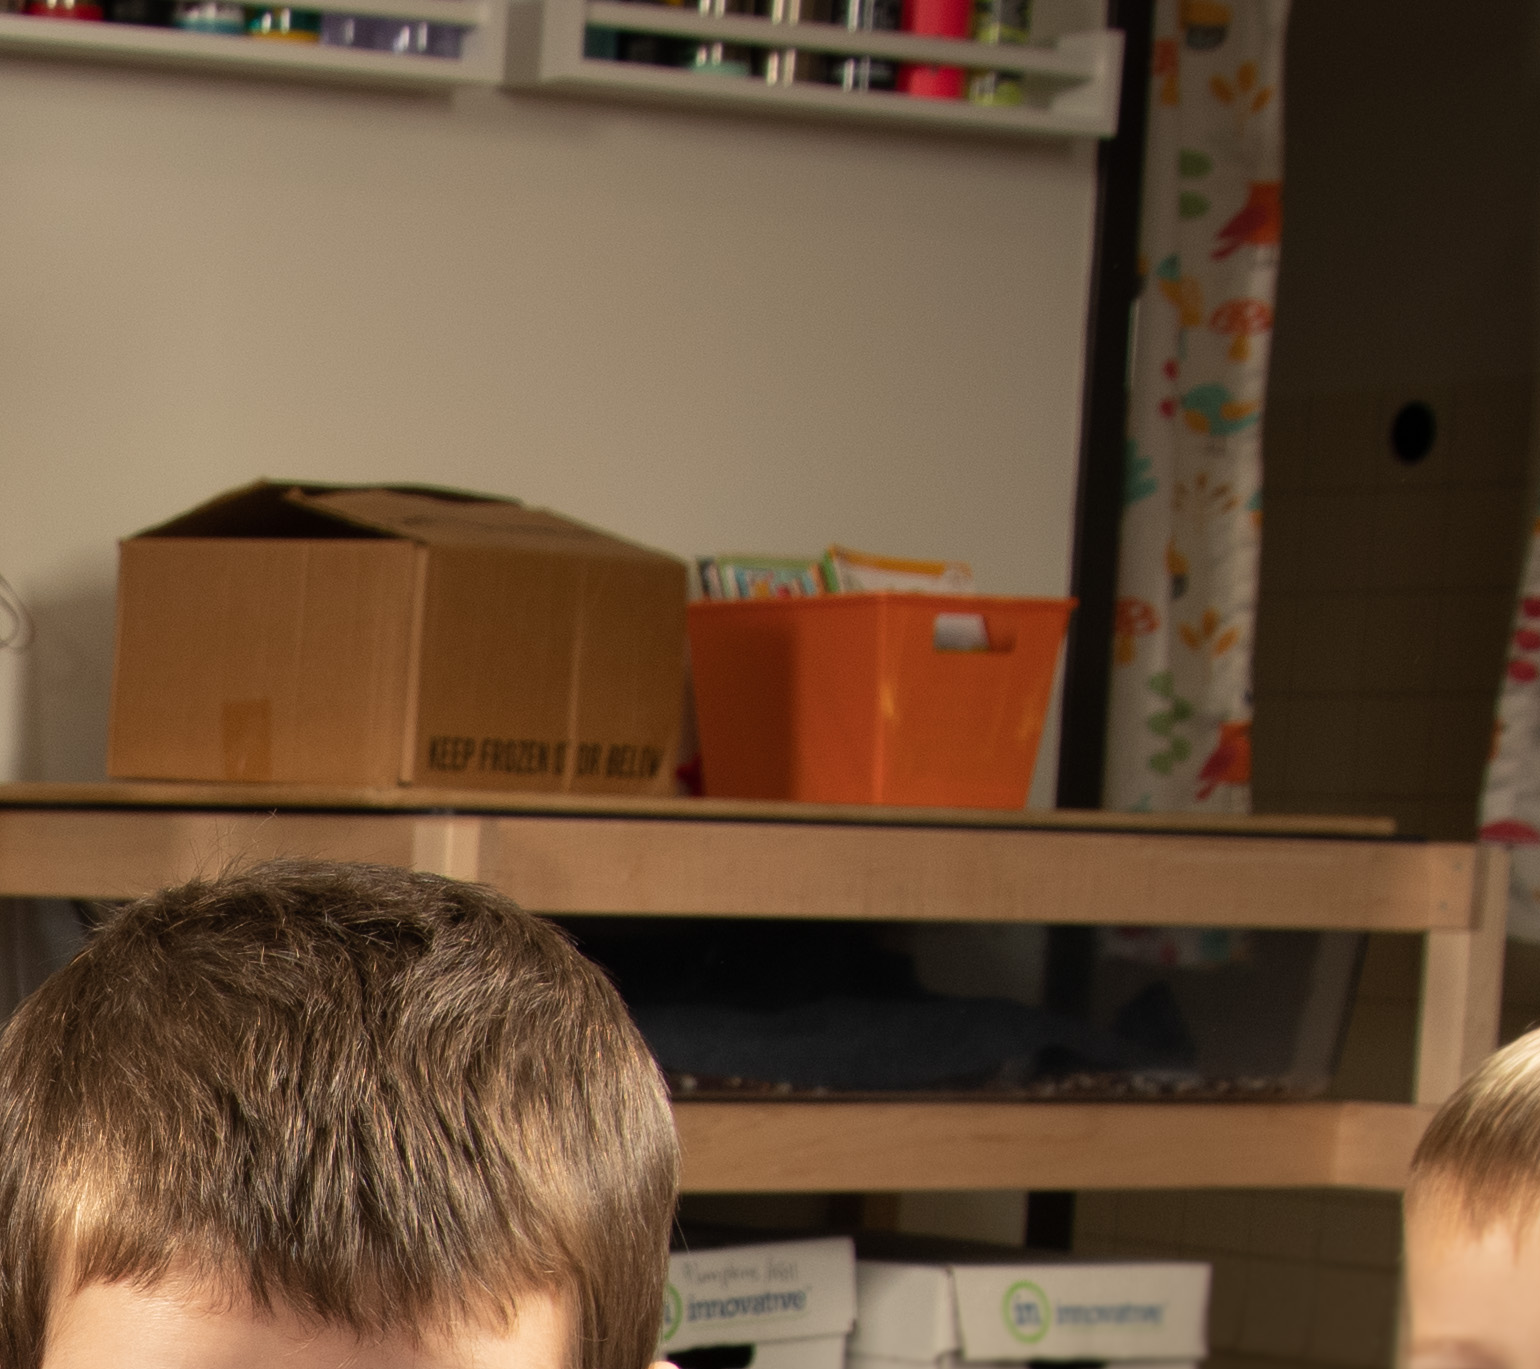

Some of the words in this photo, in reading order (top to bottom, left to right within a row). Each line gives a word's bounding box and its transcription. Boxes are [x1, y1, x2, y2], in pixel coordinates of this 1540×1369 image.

[427, 735, 473, 772] KEEP
[478, 736, 549, 775] FROZEN
[575, 741, 602, 777] OR
[605, 742, 664, 779] BELOW
[687, 1289, 807, 1322] innovative
